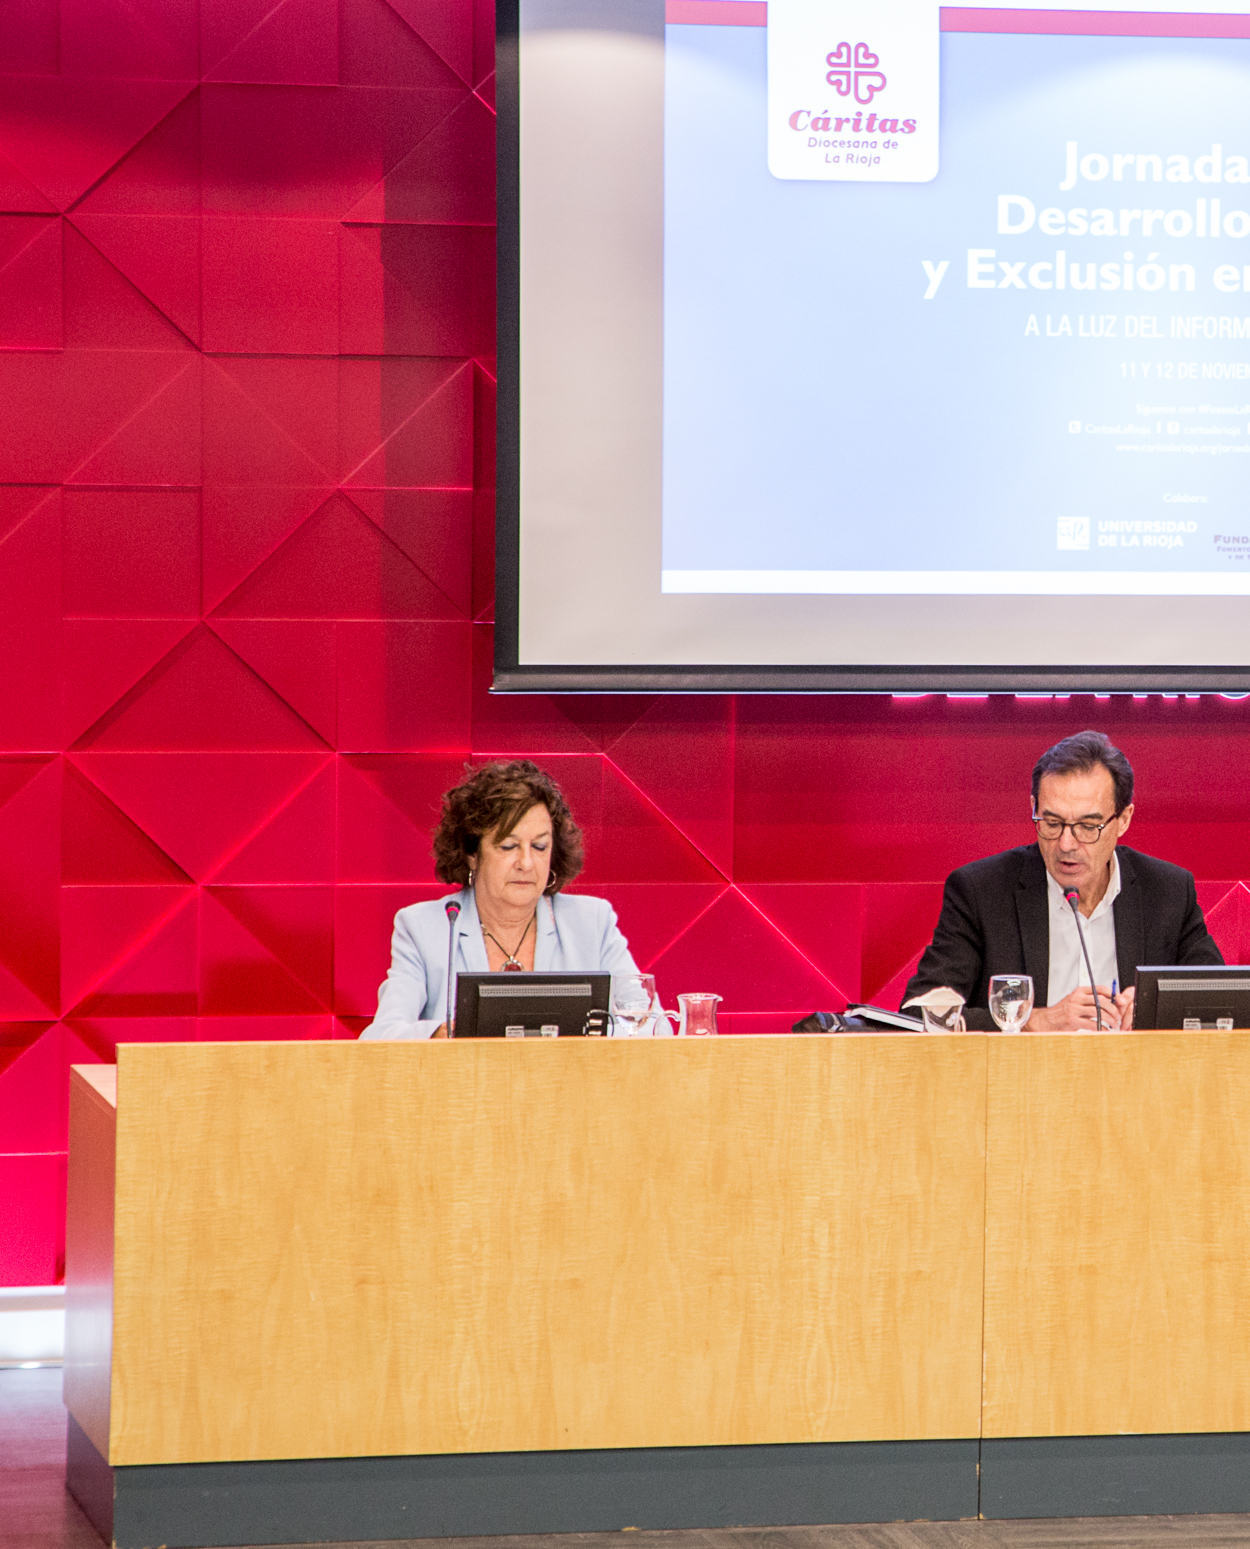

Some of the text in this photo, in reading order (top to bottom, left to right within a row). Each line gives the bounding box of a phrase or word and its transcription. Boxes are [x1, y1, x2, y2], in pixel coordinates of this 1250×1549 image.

[788, 109, 917, 134] Cáritas
[808, 137, 898, 149] Diocesana de
[825, 153, 880, 167] La Rioja
[922, 261, 949, 299] y
[968, 249, 1196, 292] Exclusión
[1025, 314, 1040, 336] A
[1047, 315, 1072, 336] LA
[1079, 315, 1117, 337] LUZ
[1125, 316, 1164, 338] DEL
[1120, 362, 1135, 378] 11
[1141, 362, 1151, 378] Y
[1156, 362, 1173, 379] 12
[1178, 362, 1197, 378] DE
[1098, 521, 1197, 533] UNIVERSIDAD
[1098, 535, 1183, 549] DE LA RIOJA
